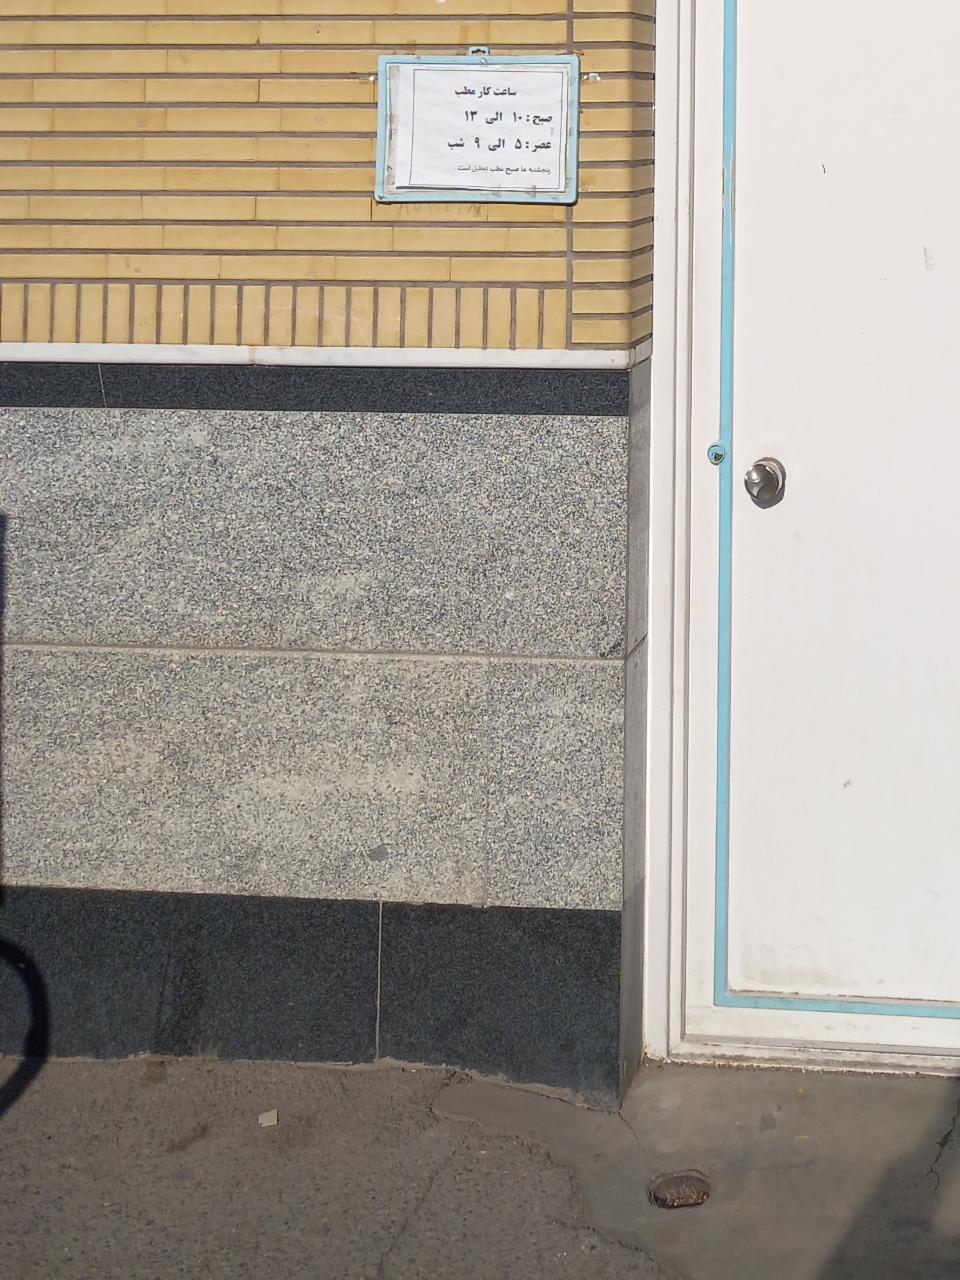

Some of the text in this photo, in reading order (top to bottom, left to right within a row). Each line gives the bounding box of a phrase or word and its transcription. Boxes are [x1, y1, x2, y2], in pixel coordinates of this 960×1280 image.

[455, 86, 517, 98] ساعت کار مطب
[464, 110, 478, 122] ۱۳
[485, 111, 503, 124] الی
[447, 137, 465, 150] شب
[474, 136, 480, 148] ۹
[488, 138, 506, 151] الی
